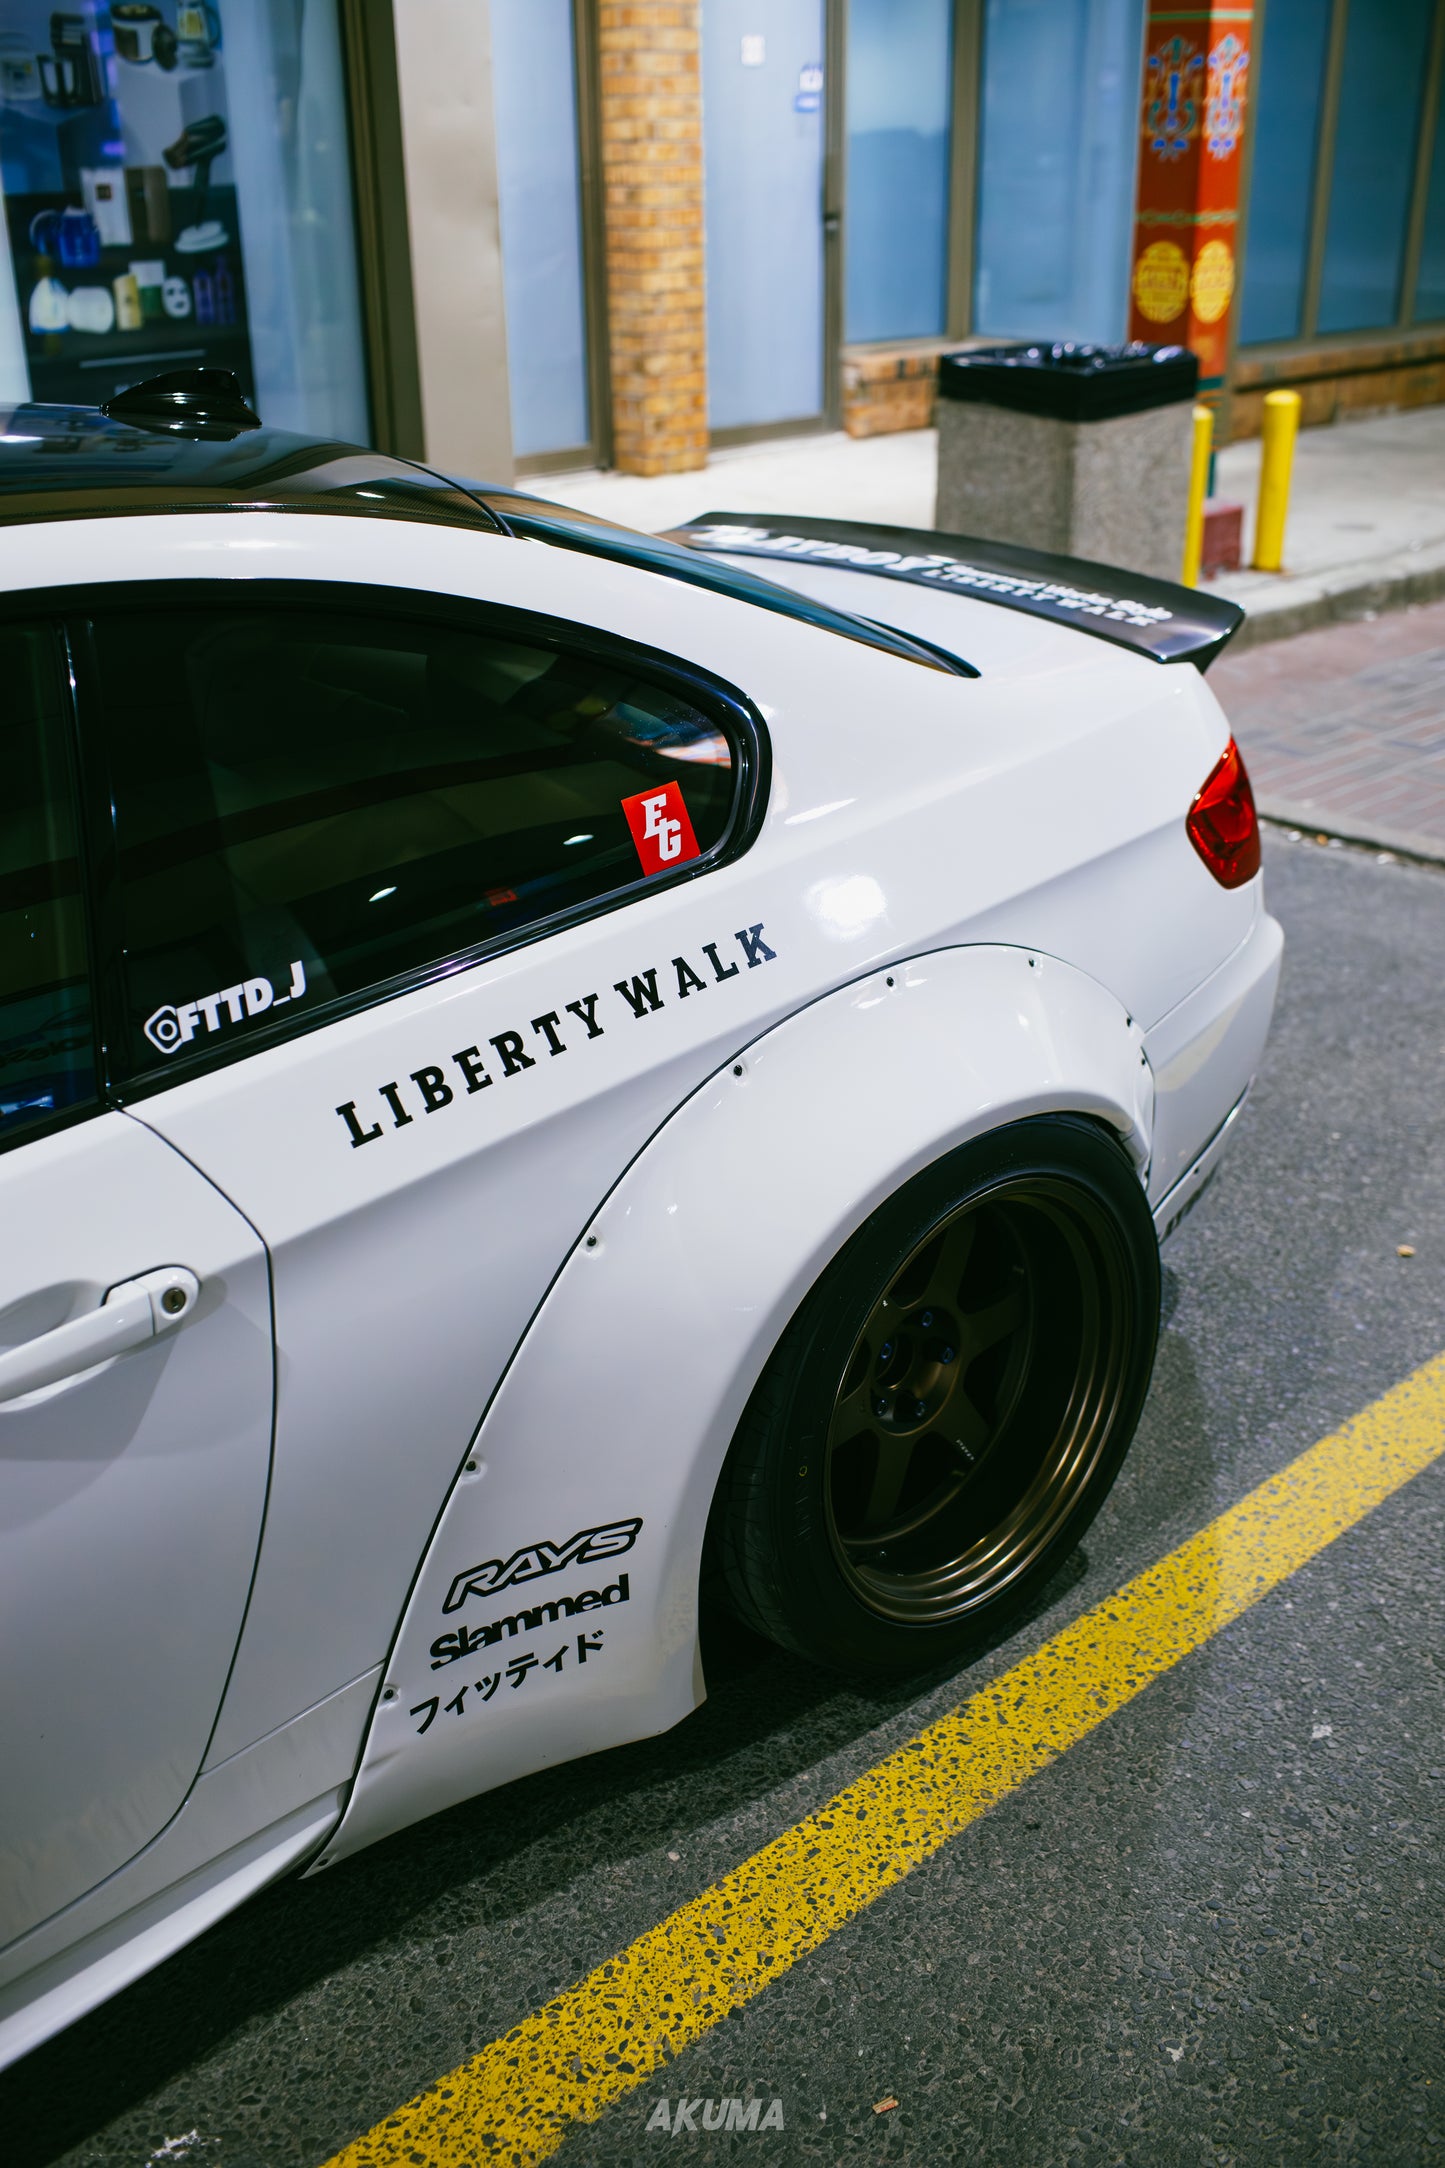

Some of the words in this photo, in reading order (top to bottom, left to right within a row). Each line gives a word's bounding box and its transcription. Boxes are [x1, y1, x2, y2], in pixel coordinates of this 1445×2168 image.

[641, 793, 681, 861] EG
[335, 993, 604, 1148] LIBERTY
[613, 923, 778, 1019] WALK
[442, 1517, 643, 1614] RAYS
[429, 1573, 630, 1671] Slammed
[409, 1629, 604, 1735] フィッティド
